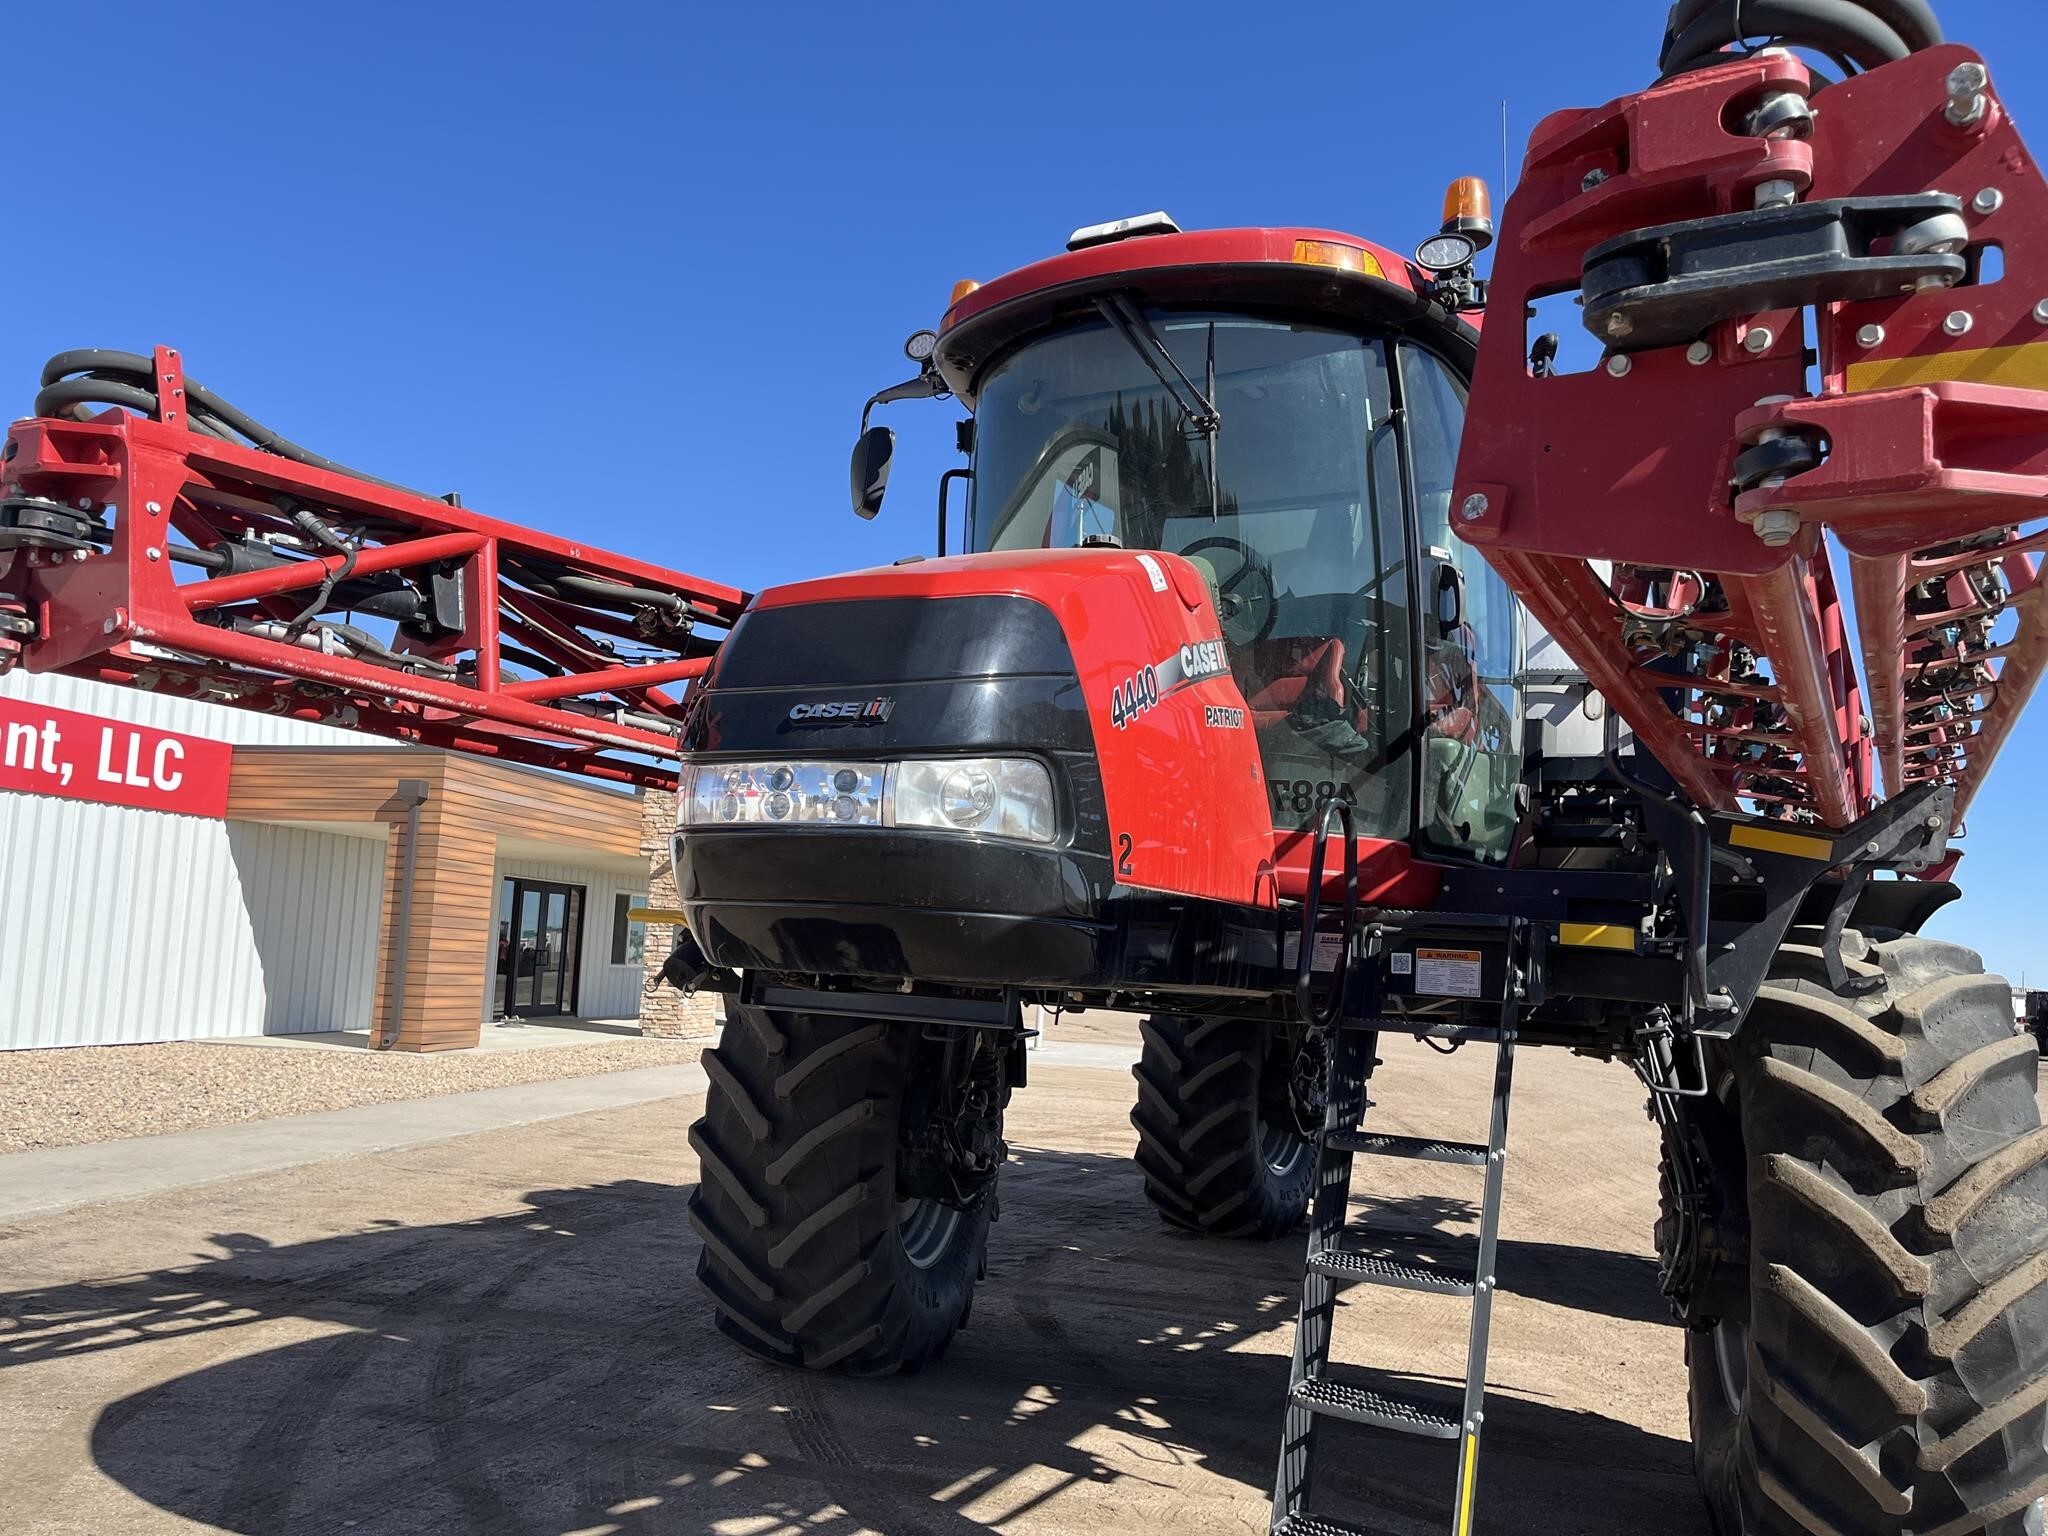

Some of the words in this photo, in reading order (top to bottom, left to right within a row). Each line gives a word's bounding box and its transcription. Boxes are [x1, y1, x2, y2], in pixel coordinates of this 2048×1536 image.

[1180, 642, 1218, 678] CASE
[789, 702, 861, 720] CASE
[1112, 665, 1159, 730] 4440
[1204, 705, 1244, 729] PATRIOT
[0, 719, 74, 786] nt,
[97, 726, 185, 792] LLC
[1118, 832, 1132, 876] 2
[1436, 952, 1469, 960] WARNING
